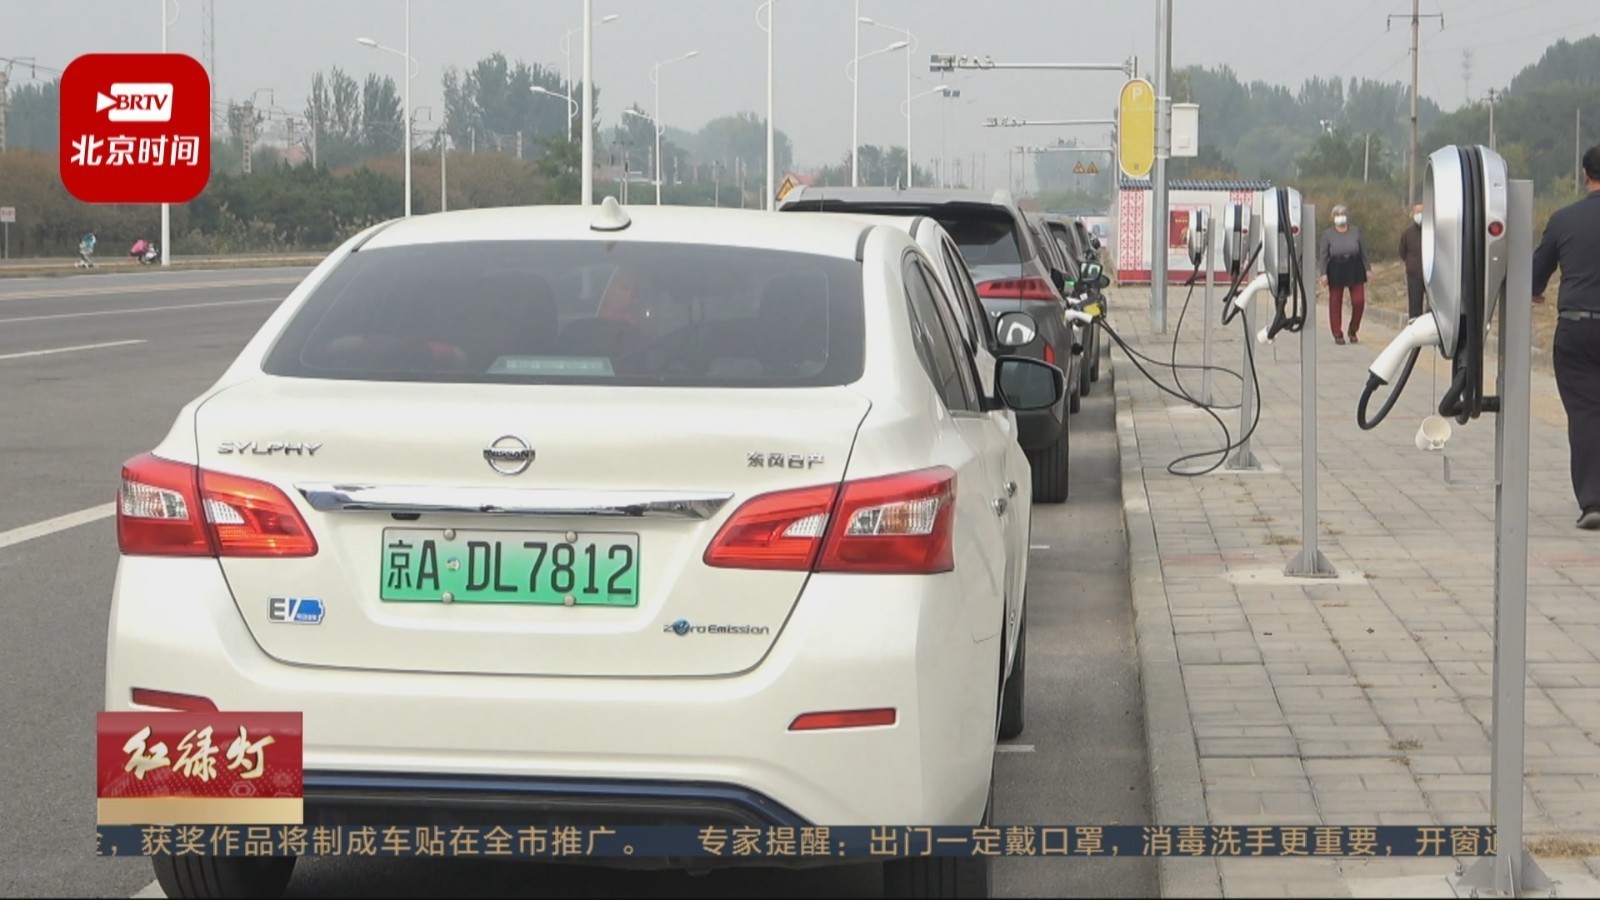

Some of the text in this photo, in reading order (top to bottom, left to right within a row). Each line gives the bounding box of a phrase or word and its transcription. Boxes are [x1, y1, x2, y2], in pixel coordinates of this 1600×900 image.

[217, 440, 323, 456] SYLPHY
[747, 452, 825, 470] 东风日产
